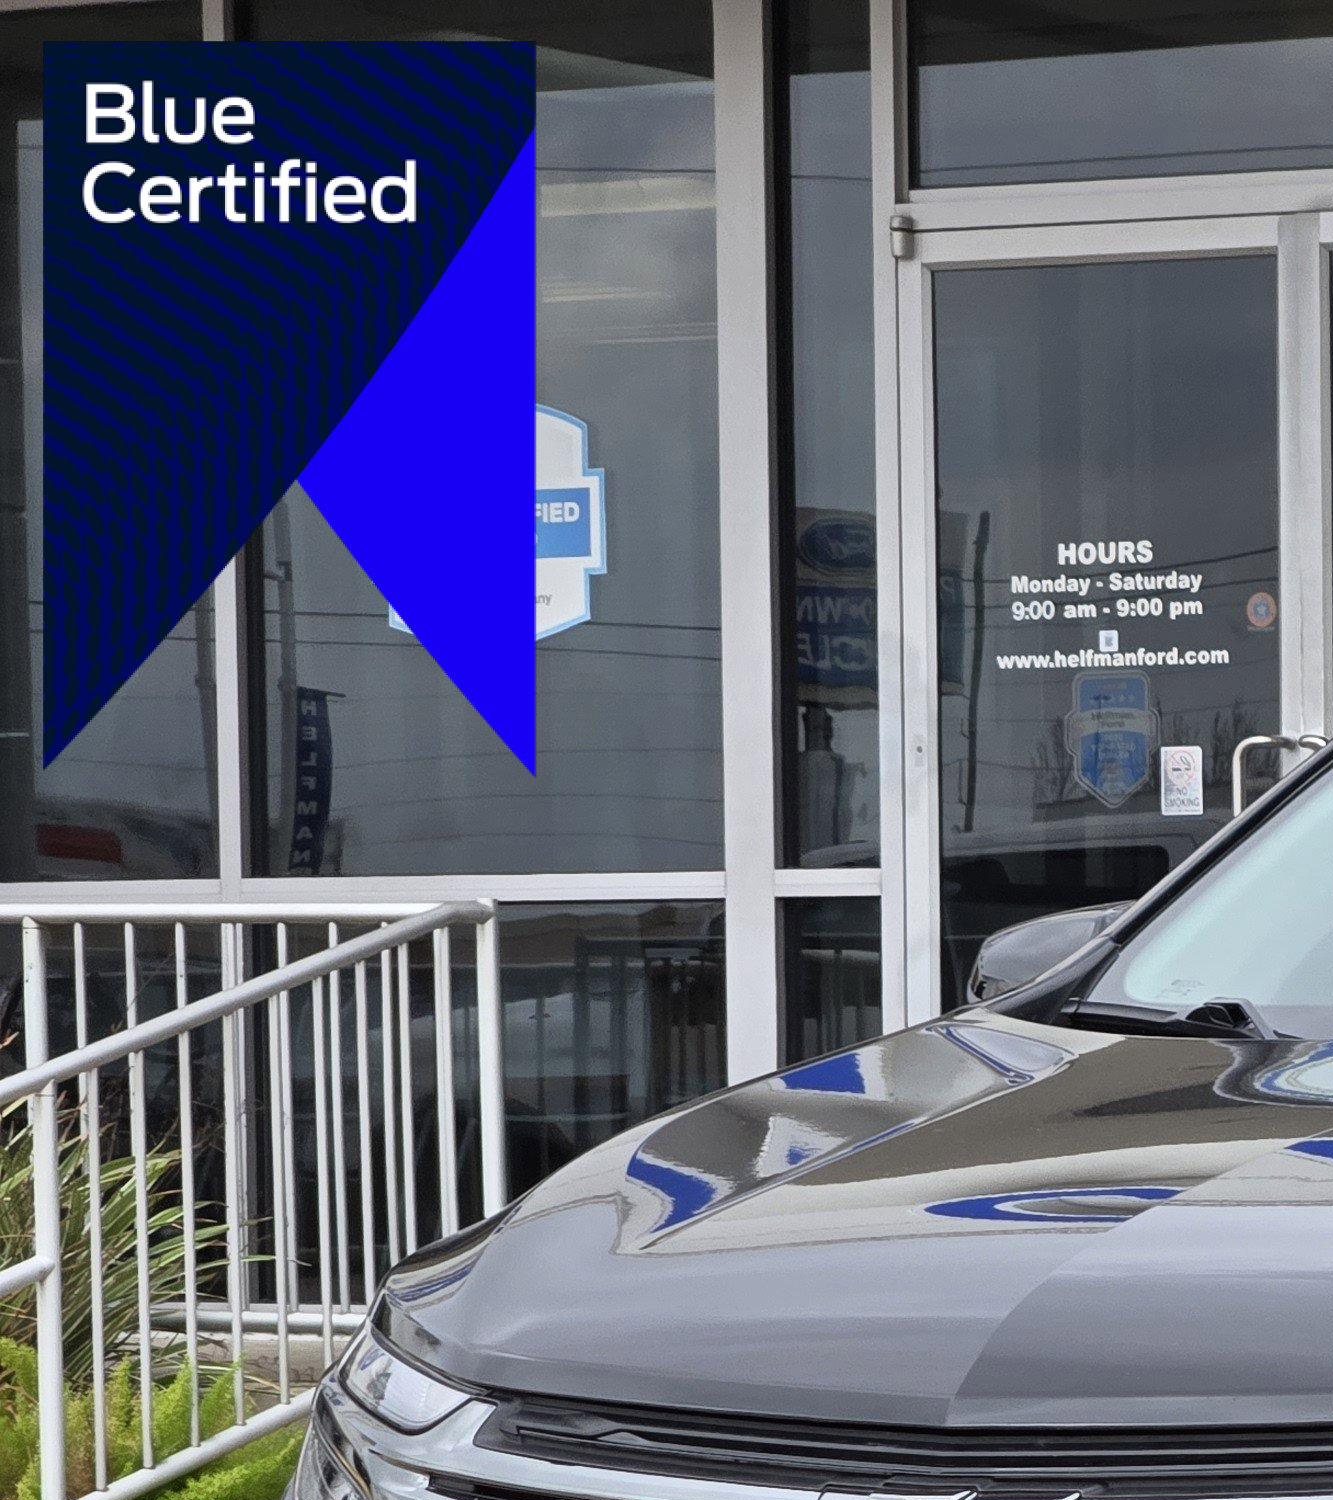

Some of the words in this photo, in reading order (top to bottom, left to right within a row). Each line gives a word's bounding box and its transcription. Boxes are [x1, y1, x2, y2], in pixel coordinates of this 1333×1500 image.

[1057, 540, 1154, 566] HOURS
[1010, 574, 1091, 596] Monday
[1108, 570, 1203, 592] Saturday
[1011, 600, 1056, 621] 9:00
[1063, 603, 1097, 619] am
[1115, 598, 1163, 618] 9:00
[1169, 600, 1204, 620] pm
[996, 647, 1230, 669] www.helfmanford.com
